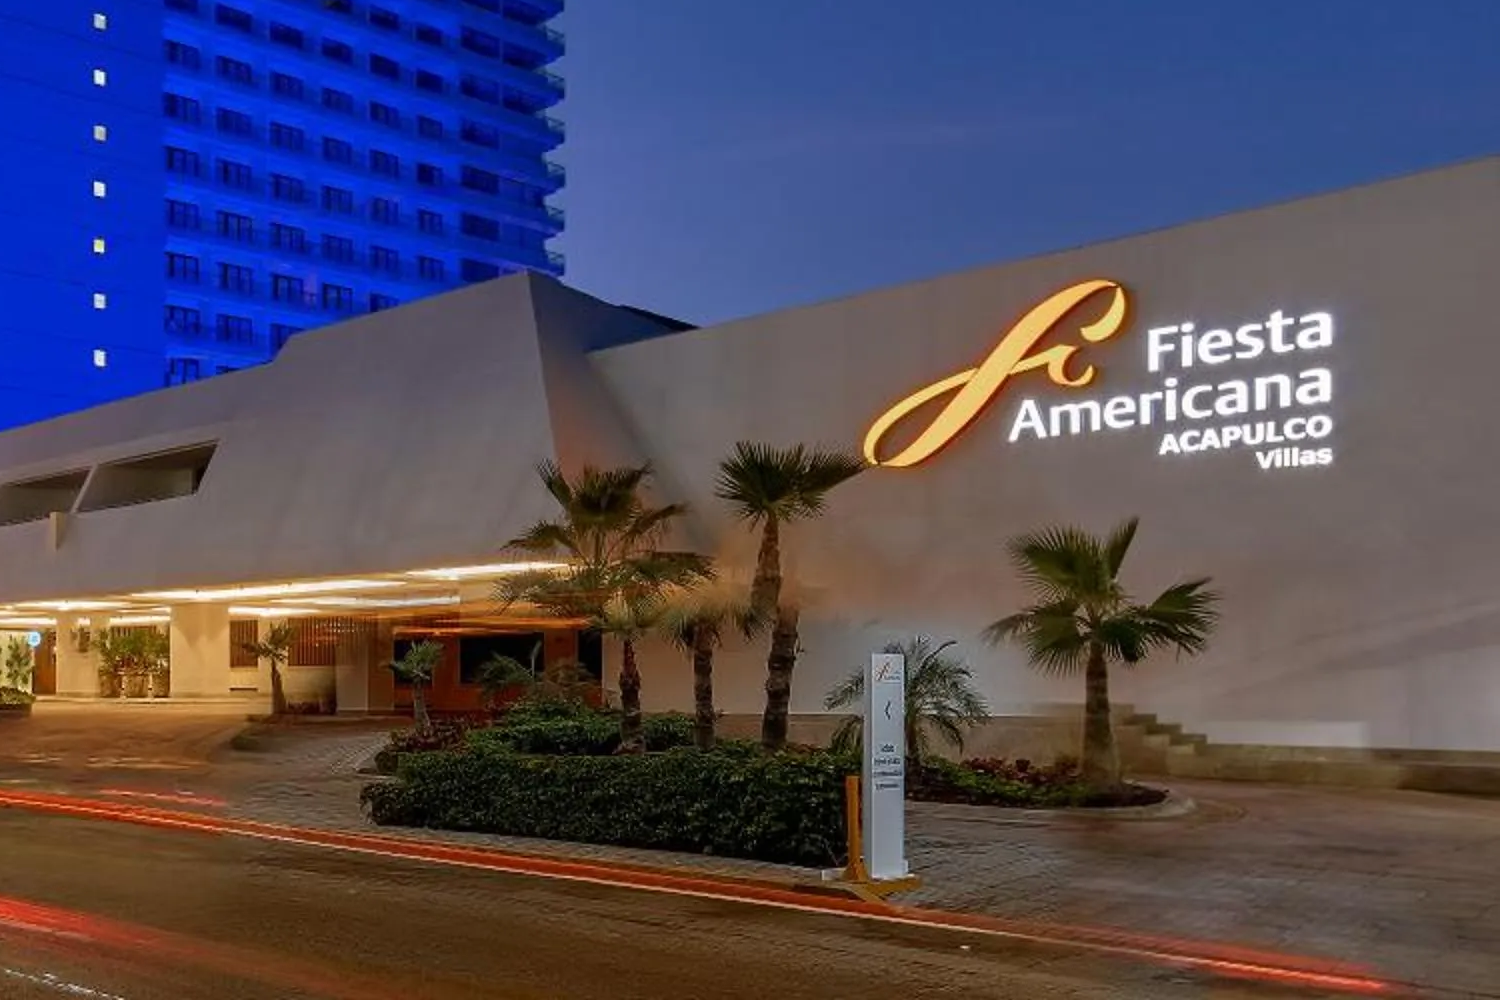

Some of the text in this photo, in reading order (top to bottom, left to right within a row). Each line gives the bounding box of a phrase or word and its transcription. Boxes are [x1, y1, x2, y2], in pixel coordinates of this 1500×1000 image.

[1147, 309, 1333, 372] Fiesta
[1008, 367, 1333, 442] Americana
[1159, 414, 1333, 455] ACAPULCO
[1255, 447, 1333, 470] Villas
